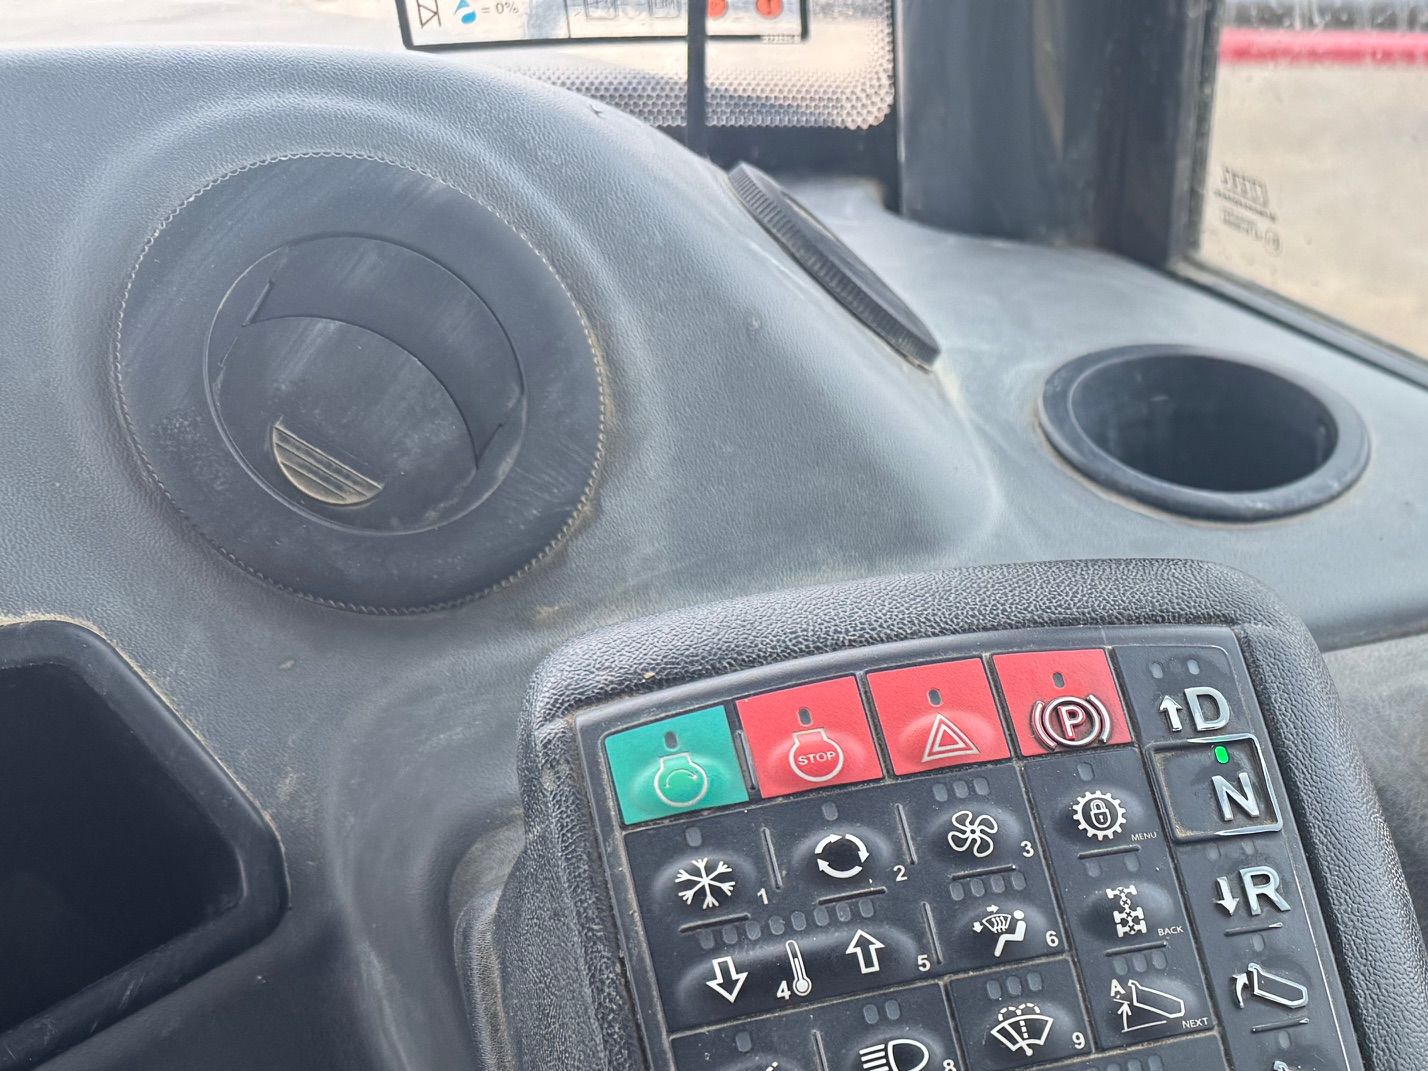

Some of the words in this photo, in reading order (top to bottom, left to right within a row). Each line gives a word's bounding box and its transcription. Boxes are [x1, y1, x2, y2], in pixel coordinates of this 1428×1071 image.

[495, 2, 520, 15] 0%
[1183, 686, 1231, 731] D
[1057, 704, 1087, 741] P
[797, 750, 836, 765] STOP
[1210, 771, 1260, 821] N
[1130, 831, 1158, 842] MENU
[1020, 840, 1035, 858] 3
[893, 865, 908, 882] 2
[757, 888, 769, 905] 1
[1238, 865, 1291, 916] R
[1045, 930, 1060, 948] 6
[1157, 925, 1185, 938] BACK
[917, 954, 931, 972] 5
[776, 980, 792, 1000] 4
[1110, 978, 1126, 997] A
[1181, 1016, 1209, 1030] NEXT
[1071, 1031, 1086, 1050] 9
